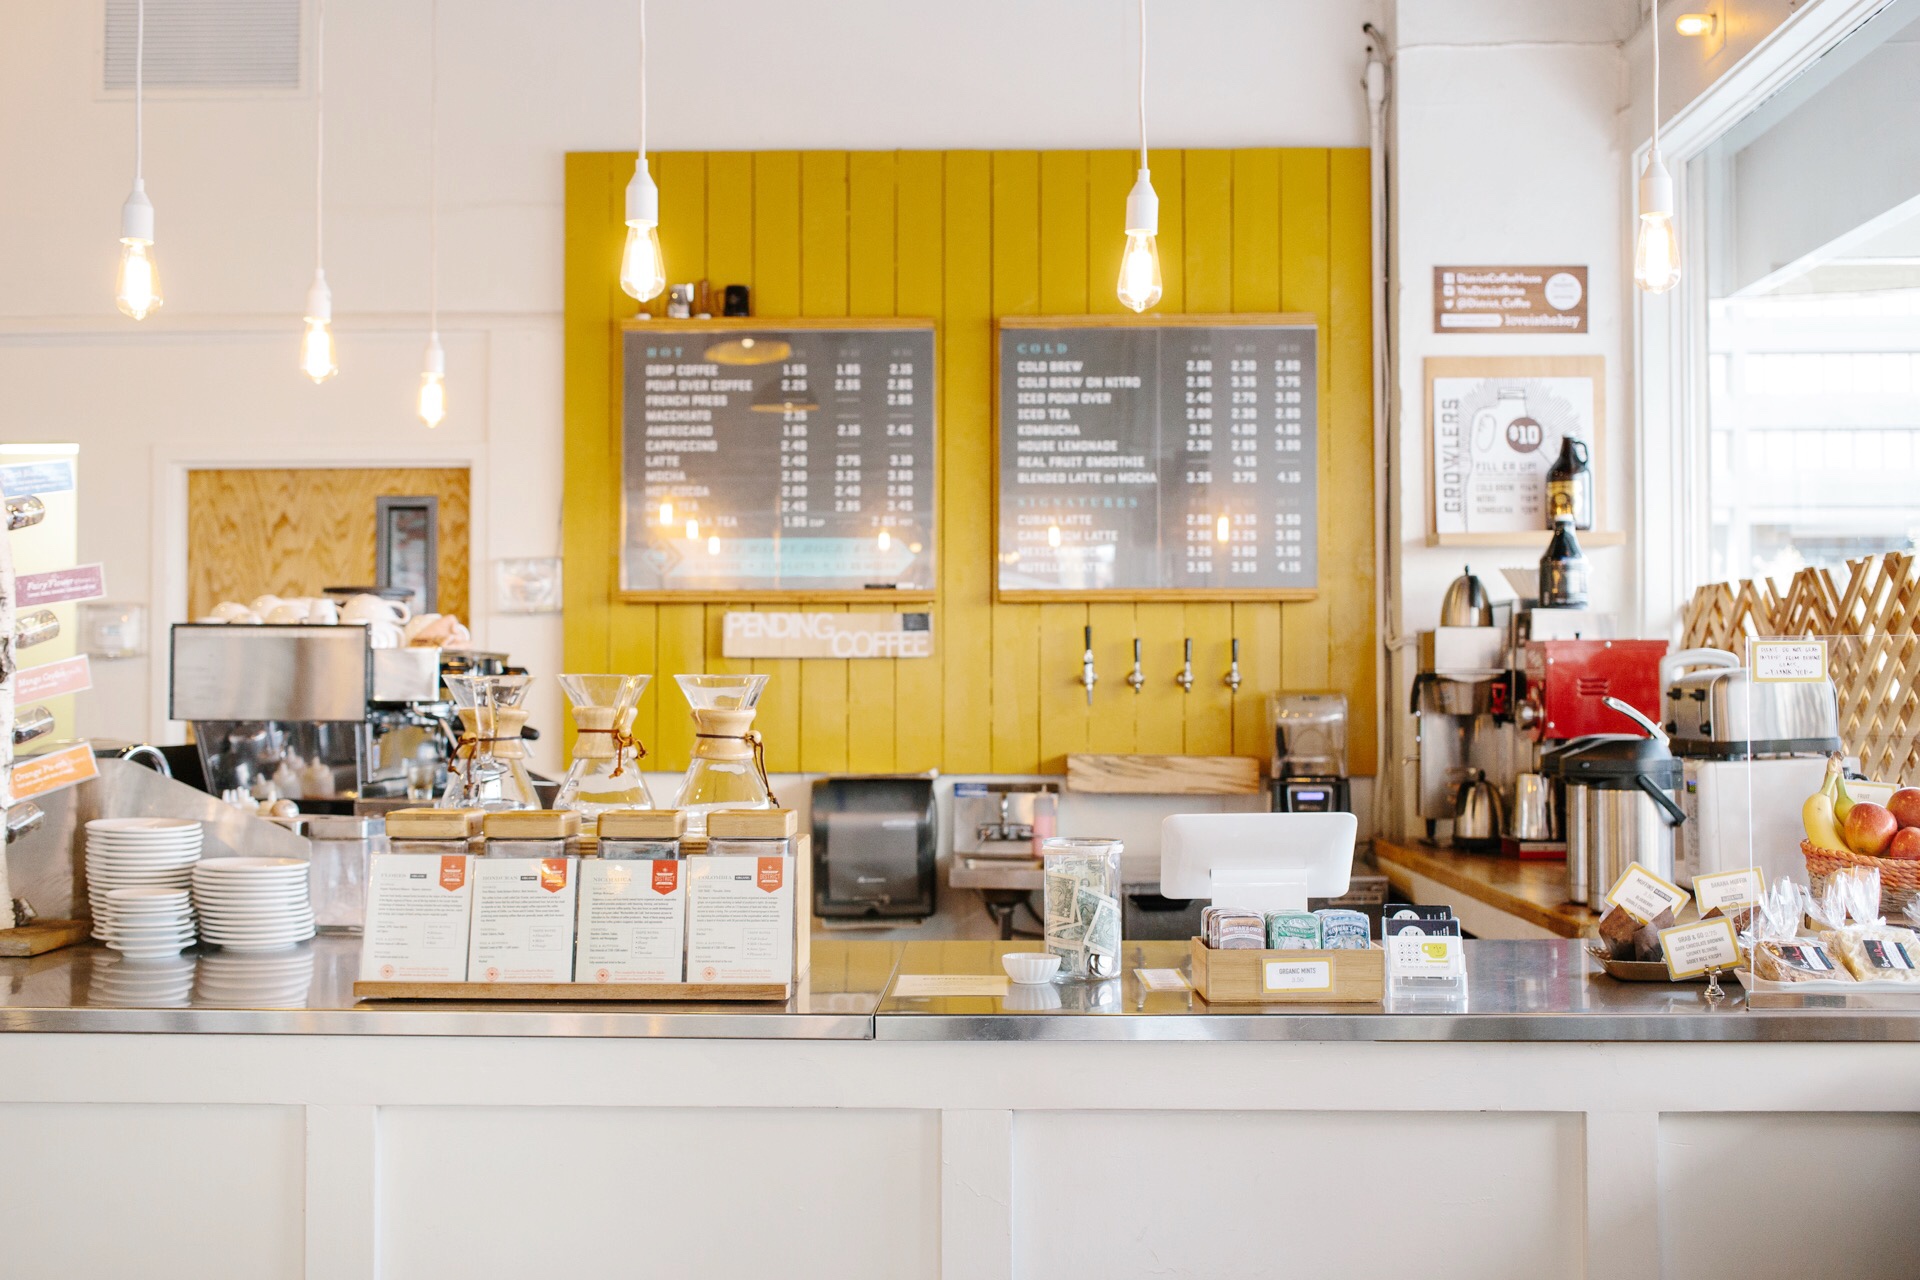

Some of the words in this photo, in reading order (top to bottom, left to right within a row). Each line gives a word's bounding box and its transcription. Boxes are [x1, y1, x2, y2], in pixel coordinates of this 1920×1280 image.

[1017, 343, 1067, 355] COLD
[646, 364, 675, 377] DRIP
[676, 364, 719, 377] COFFEE
[1017, 361, 1048, 373] COLD
[1049, 361, 1083, 373] BREW
[646, 379, 677, 392] POUR
[678, 379, 710, 392] OVER
[711, 379, 753, 392] COFFEE
[1017, 377, 1048, 389] COLD
[1049, 377, 1084, 389] BREW
[1086, 377, 1103, 389] ON
[1105, 377, 1141, 389] NITRO
[646, 394, 690, 407] FRENCH
[692, 394, 728, 407] PRESS
[1017, 392, 1046, 405] ICED
[1048, 392, 1079, 405] POUR
[1081, 392, 1112, 405] OVER
[646, 409, 712, 422] MACCHIATO
[1017, 408, 1046, 420] ICED
[1047, 408, 1071, 420] TEA
[646, 425, 714, 437] AMERICANO
[1017, 424, 1081, 437] KOMBUCHA
[646, 440, 718, 452] CAPPUCCINO
[1017, 440, 1056, 452] HOUSE
[1057, 440, 1118, 452] LEMONADE
[645, 455, 680, 467] LATTE
[1442, 397, 1462, 513] GROWLERS
[1017, 456, 1048, 468] REAL
[1049, 456, 1083, 468] FRUIT
[1086, 456, 1145, 468] SMOOTHIE
[645, 470, 686, 482] MOCHA
[1017, 472, 1067, 484] BLENDED
[1068, 472, 1102, 484] LATTE
[1117, 472, 1158, 484] MOCHA
[671, 485, 710, 497] COCOA
[1017, 497, 1138, 509] SIGNATURES
[1017, 514, 1057, 526] CUBAN
[1058, 514, 1092, 526] LATTE
[1084, 530, 1118, 542] LATTE
[727, 612, 836, 640] PENDING
[832, 630, 929, 657] COFFEE
[1677, 935, 1692, 943] GRAB
[1685, 940, 1707, 949] CHOCOLATE
[1707, 936, 1725, 944] BROWNIE
